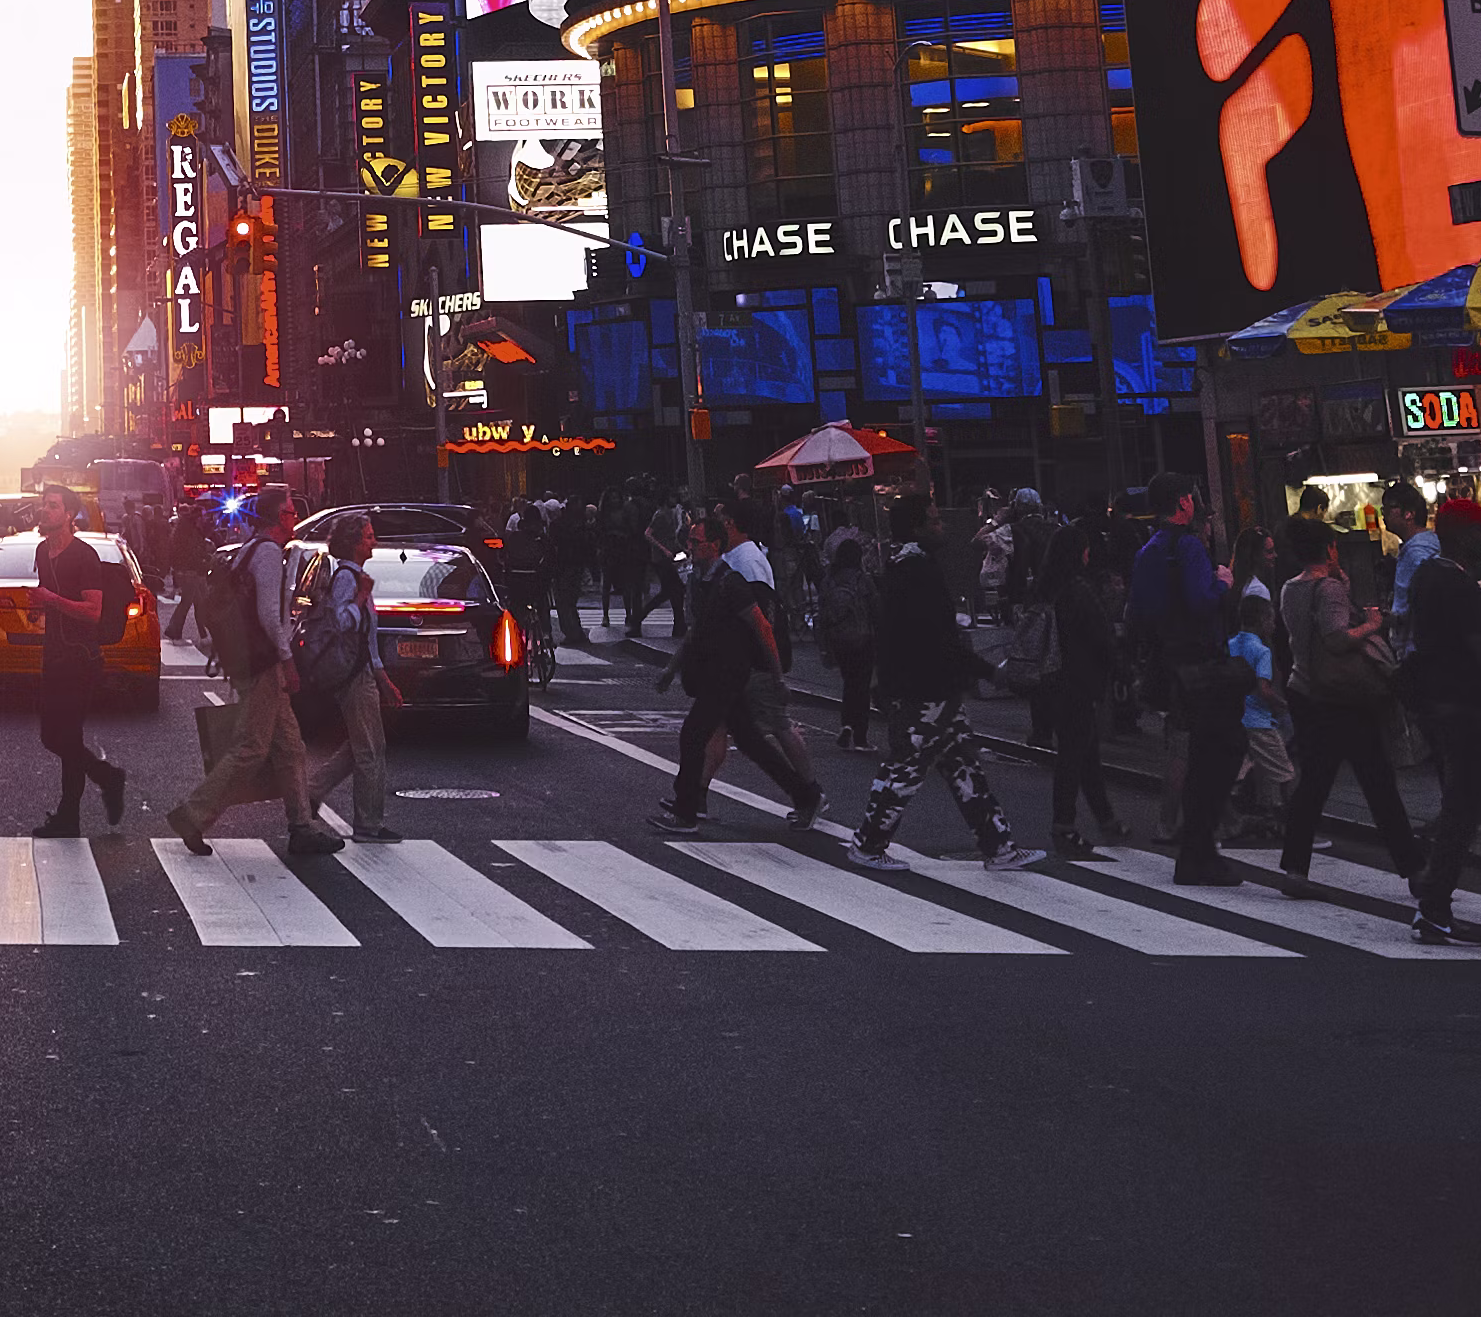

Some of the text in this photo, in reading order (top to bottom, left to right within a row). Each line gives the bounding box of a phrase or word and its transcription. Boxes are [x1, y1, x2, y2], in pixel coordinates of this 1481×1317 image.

[249, 18, 278, 112] STUDIOS
[418, 12, 450, 146] VICTORY
[492, 90, 596, 110] WORK
[495, 118, 597, 126] FOOTWEAR
[254, 123, 280, 179] DUKE
[171, 145, 200, 334] REGAL
[366, 214, 389, 267] NEW
[723, 223, 836, 263] CHASE
[888, 211, 1038, 250] CHASE
[410, 291, 481, 318] SKCHERS
[1403, 391, 1480, 430] SODA
[236, 436, 250, 446] 25
